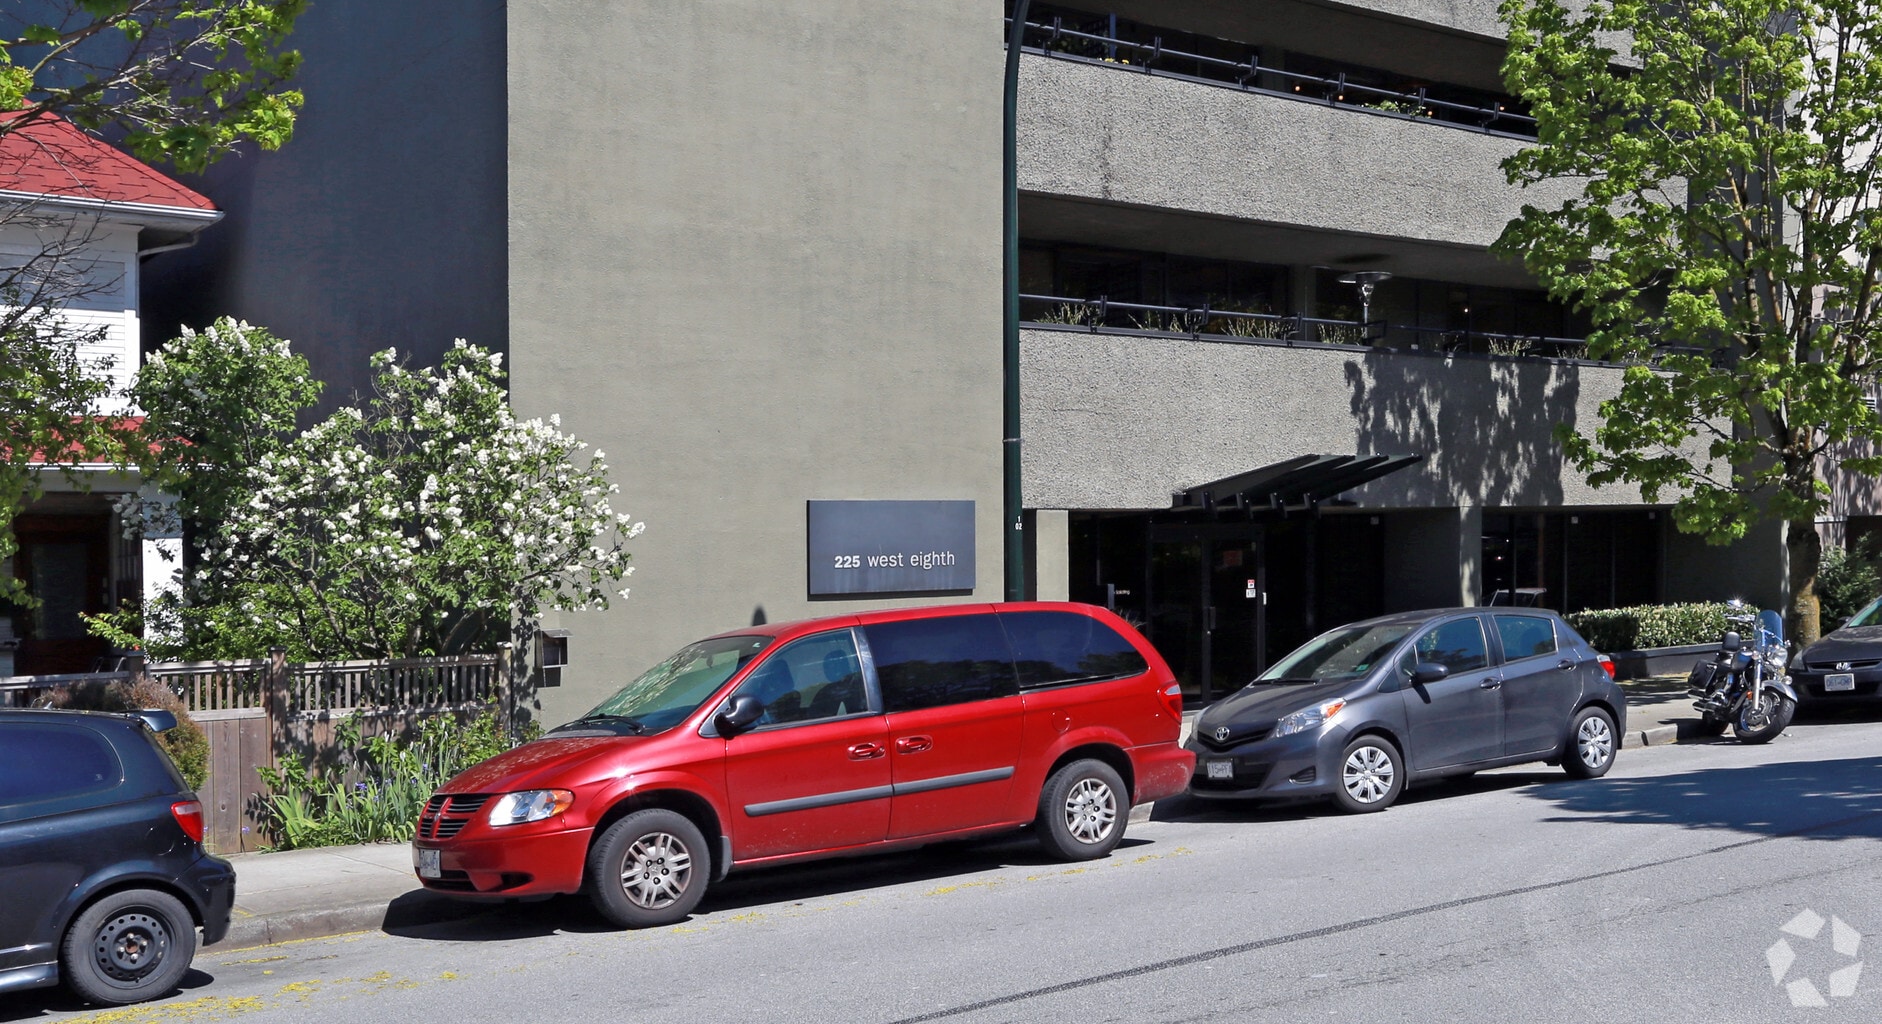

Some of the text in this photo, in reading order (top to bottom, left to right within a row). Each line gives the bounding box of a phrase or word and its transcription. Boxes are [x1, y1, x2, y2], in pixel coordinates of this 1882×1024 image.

[834, 551, 955, 569] 225 west eighth
